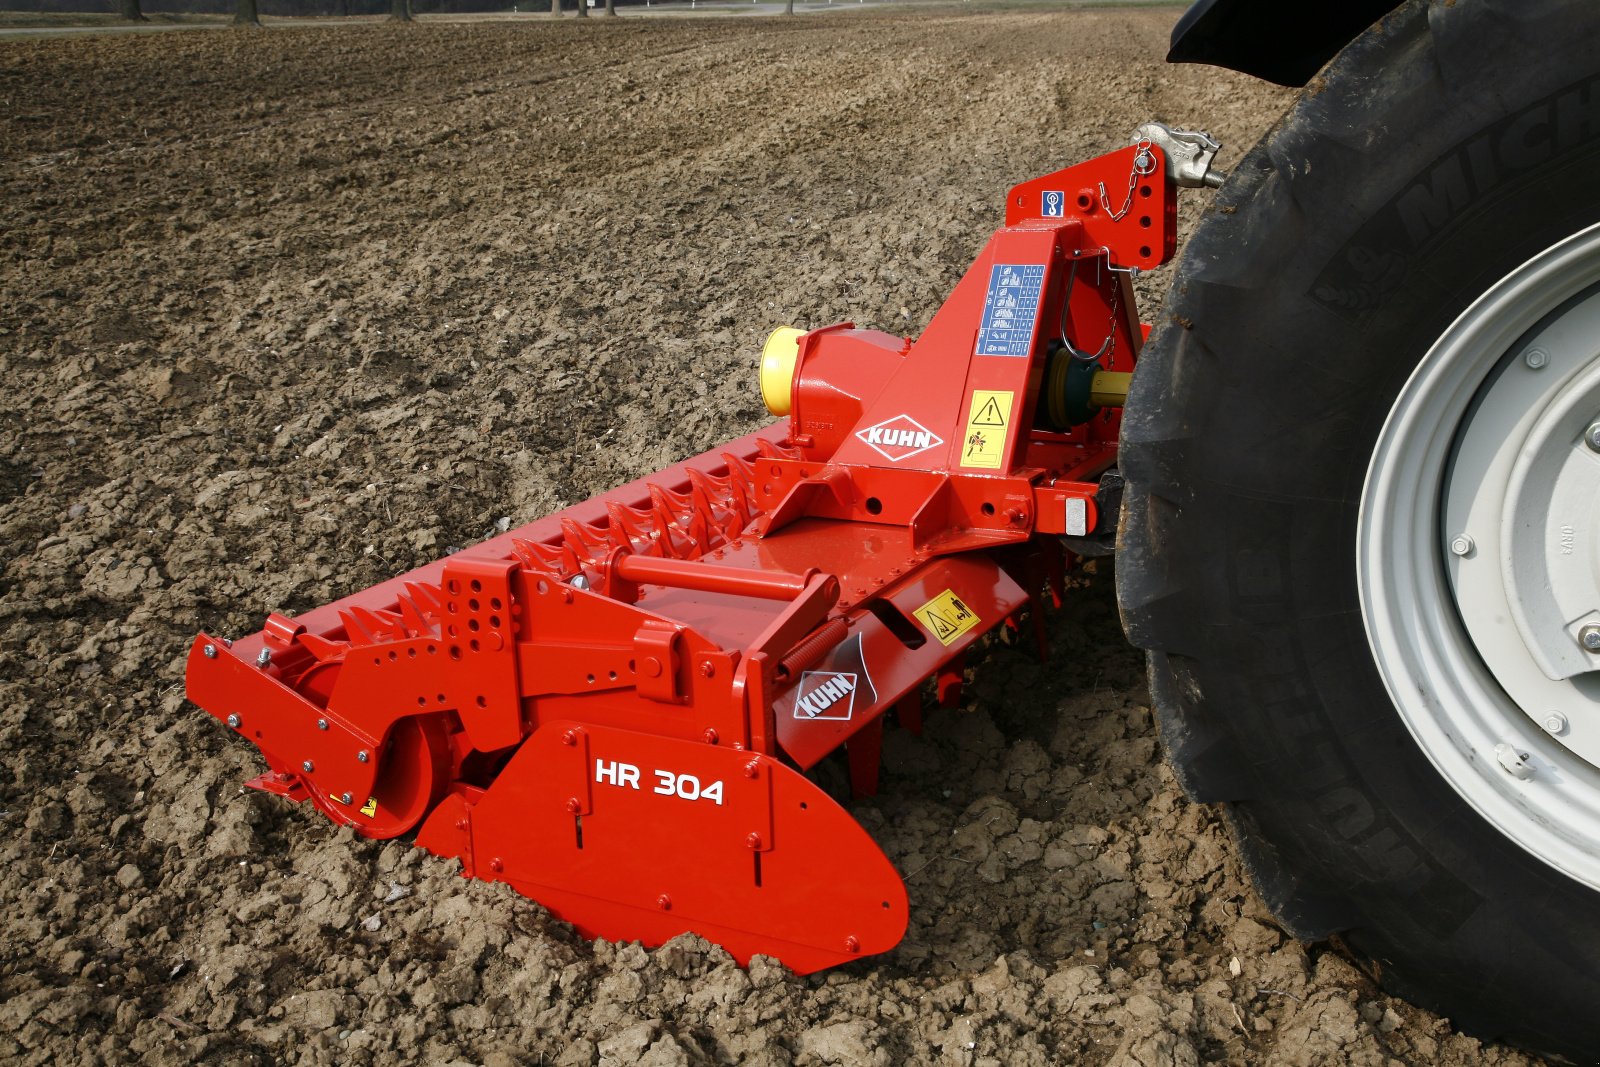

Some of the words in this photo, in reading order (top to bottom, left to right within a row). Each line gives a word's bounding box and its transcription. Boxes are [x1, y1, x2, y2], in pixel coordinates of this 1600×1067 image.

[868, 427, 931, 448] KUHN
[797, 673, 854, 718] KUHN
[596, 758, 640, 790] HR
[653, 769, 723, 805] 304
